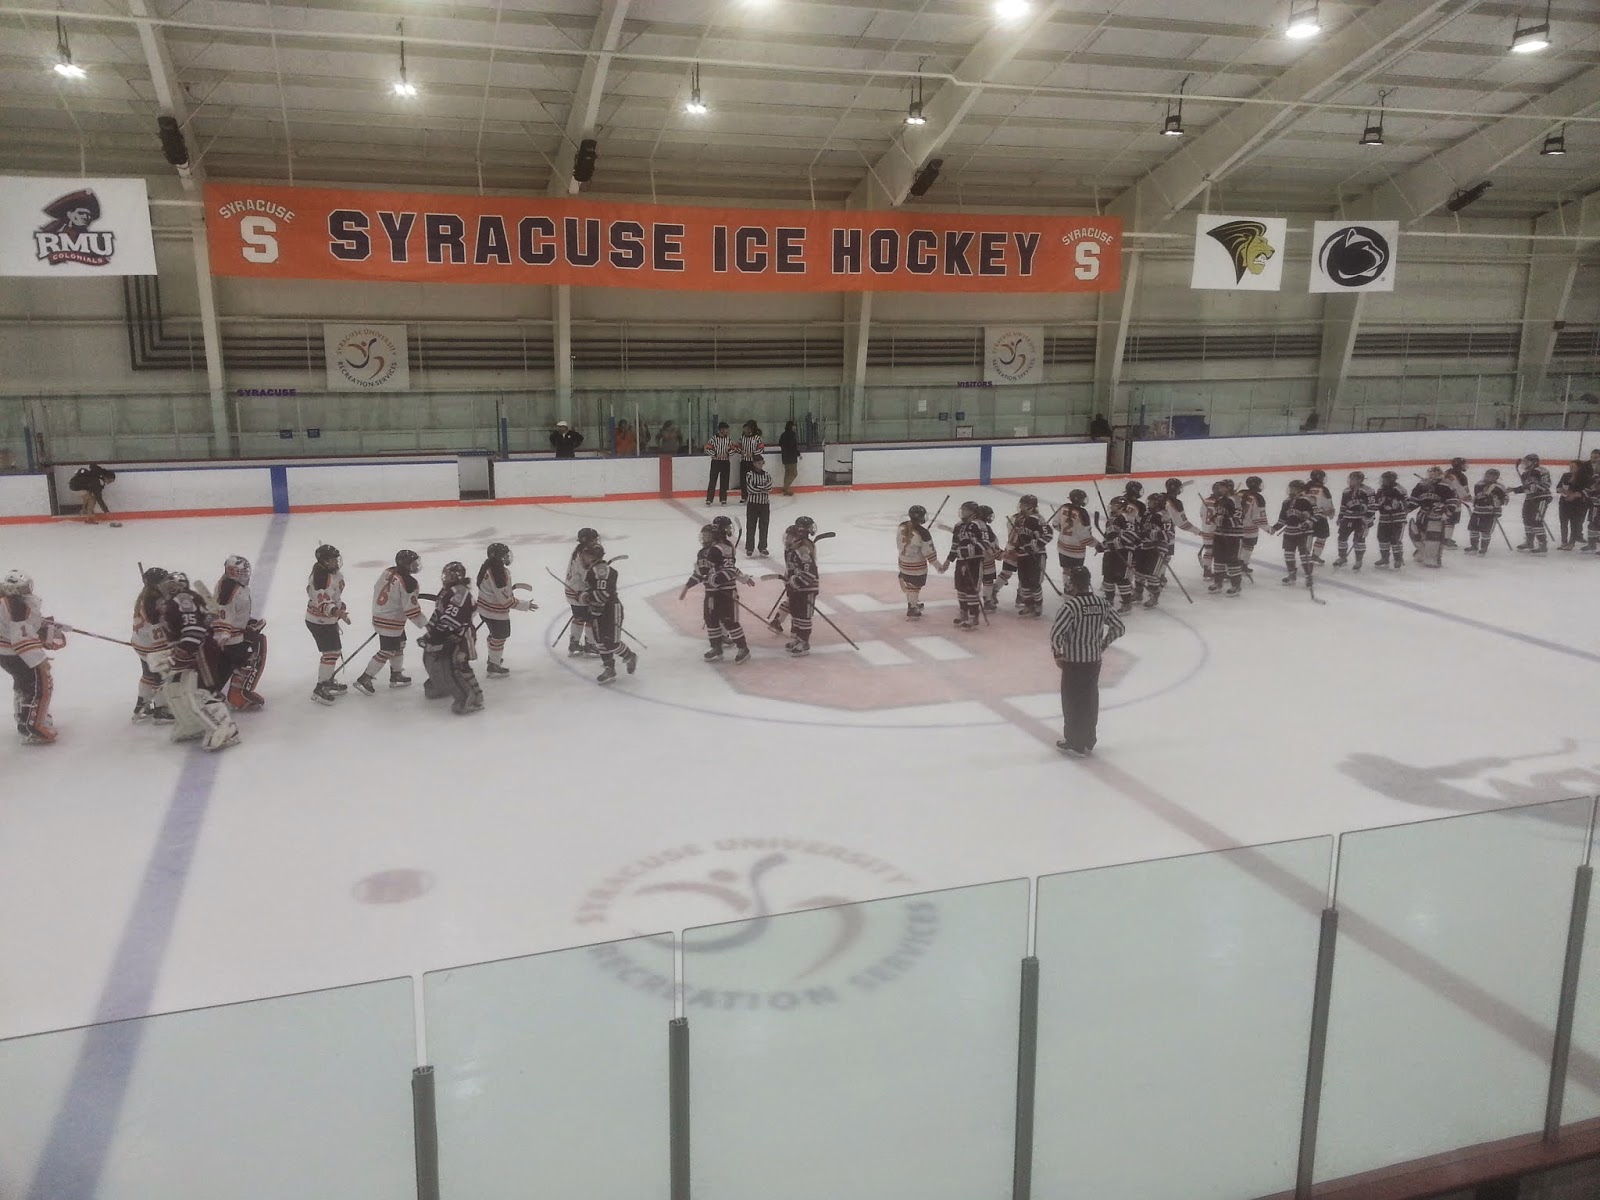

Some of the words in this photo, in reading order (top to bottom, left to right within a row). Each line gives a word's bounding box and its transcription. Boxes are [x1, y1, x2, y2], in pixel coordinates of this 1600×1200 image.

[219, 199, 296, 223] SYRACUSE
[34, 231, 114, 260] RMU
[240, 215, 279, 264] S
[327, 208, 686, 272] SYRACUSE
[712, 225, 807, 275] ICE
[831, 228, 1041, 277] HOCKEY
[1062, 227, 1114, 246] SYRACUSE
[52, 252, 103, 264] COLONIALS
[1074, 241, 1101, 281] S
[338, 361, 374, 388] RECREATION
[374, 361, 398, 387] SERVICES
[957, 380, 993, 388] VISITORS
[237, 388, 297, 397] SYRACUSE
[180, 613, 198, 626] 35
[444, 603, 461, 618] 29
